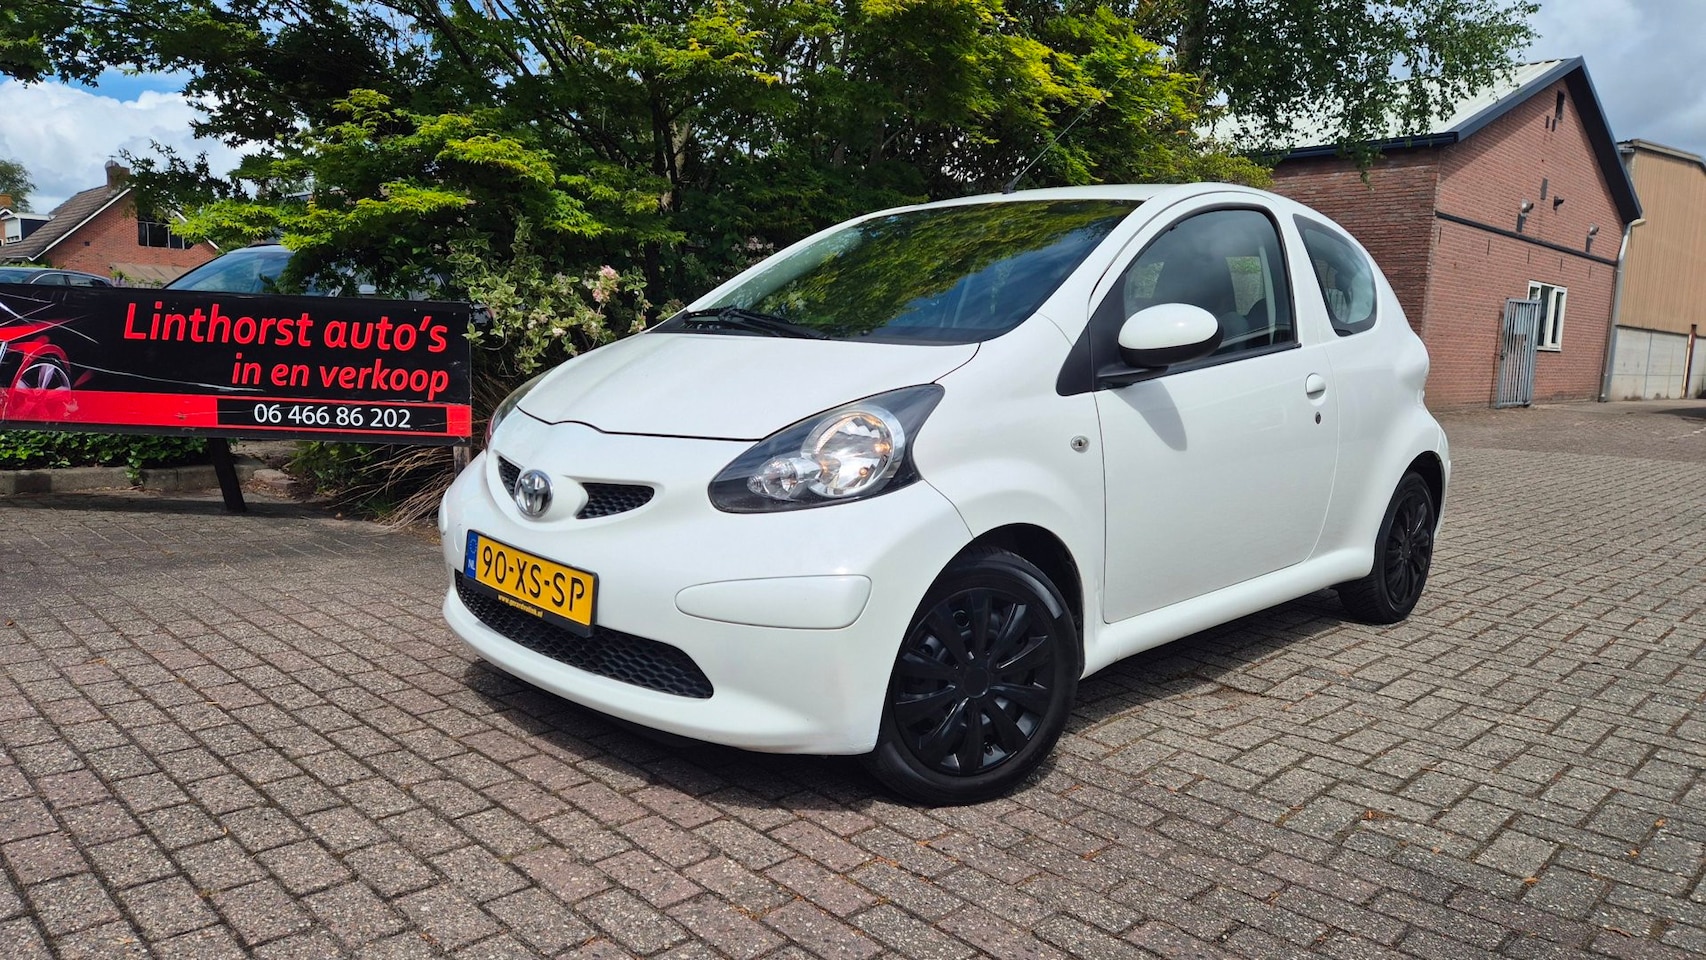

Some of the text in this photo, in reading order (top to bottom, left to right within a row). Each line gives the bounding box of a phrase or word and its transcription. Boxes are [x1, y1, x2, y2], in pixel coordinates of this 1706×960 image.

[123, 301, 448, 353] Linthorst auto's
[232, 353, 448, 401] in en verkoop
[254, 404, 411, 428] 06 466 86 202
[468, 559, 475, 570] NL
[483, 546, 585, 611] 90-XS-SP
